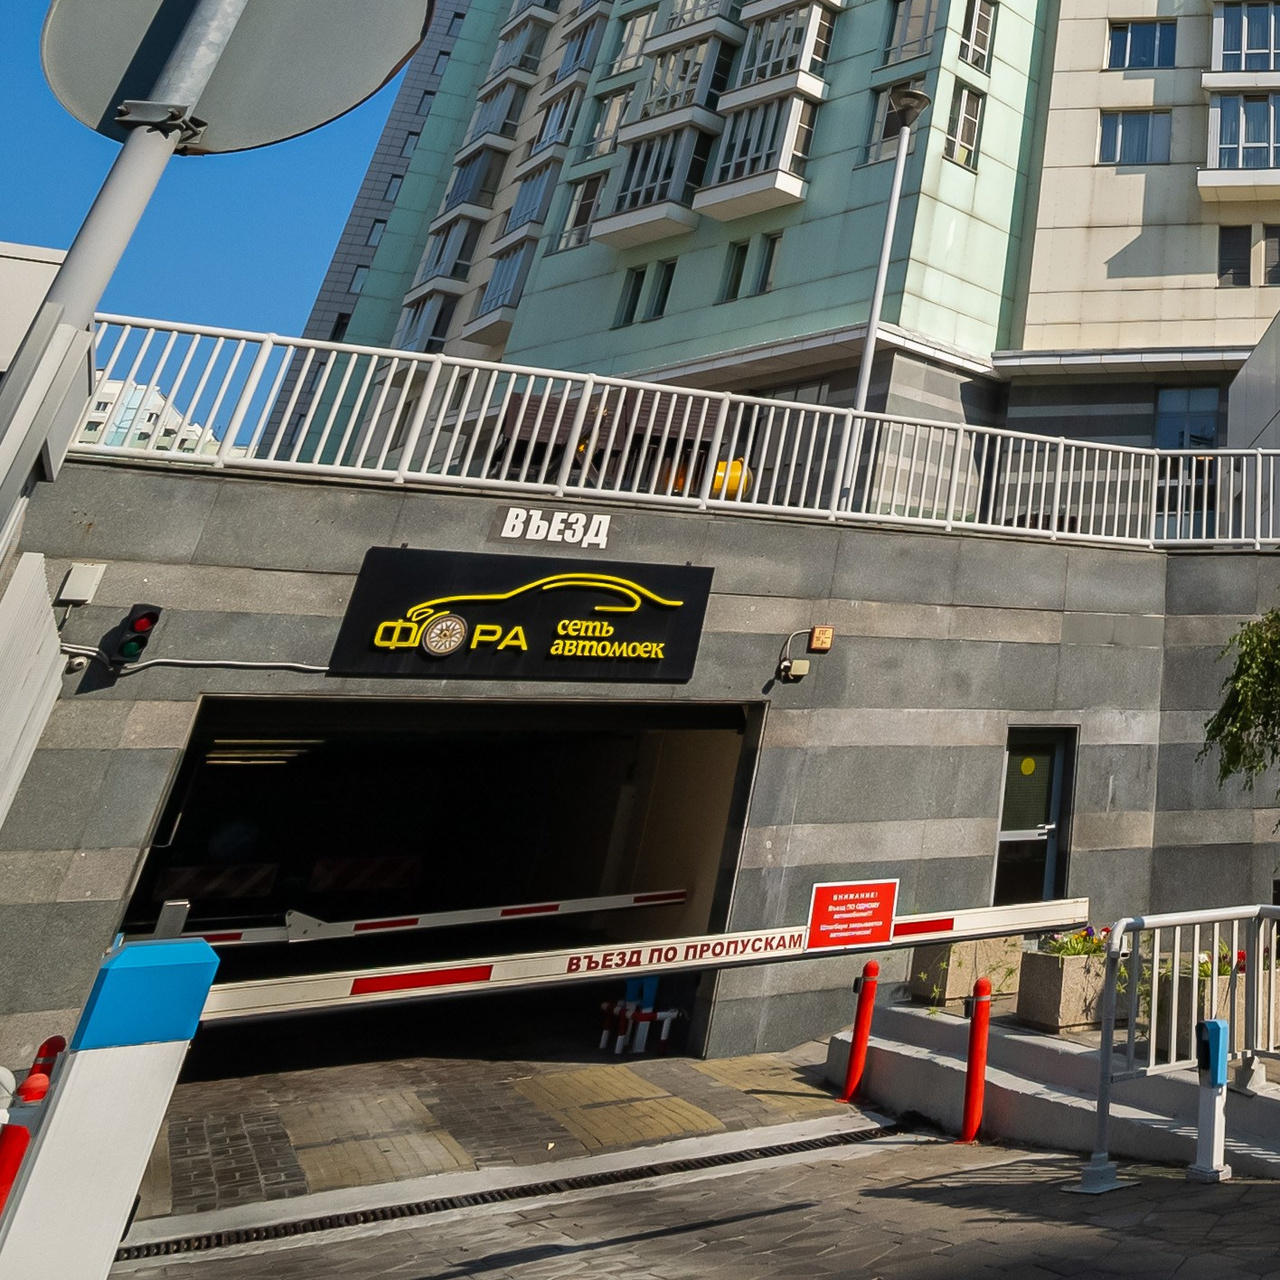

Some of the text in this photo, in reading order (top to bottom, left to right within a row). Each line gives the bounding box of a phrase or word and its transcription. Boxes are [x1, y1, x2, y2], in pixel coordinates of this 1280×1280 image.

[501, 507, 612, 549] ВЪЕЗД
[557, 618, 614, 636] сеть
[550, 638, 665, 659] автомоек
[566, 933, 803, 974] ВЪЕЗД ПО ПРОПУСКАМ
